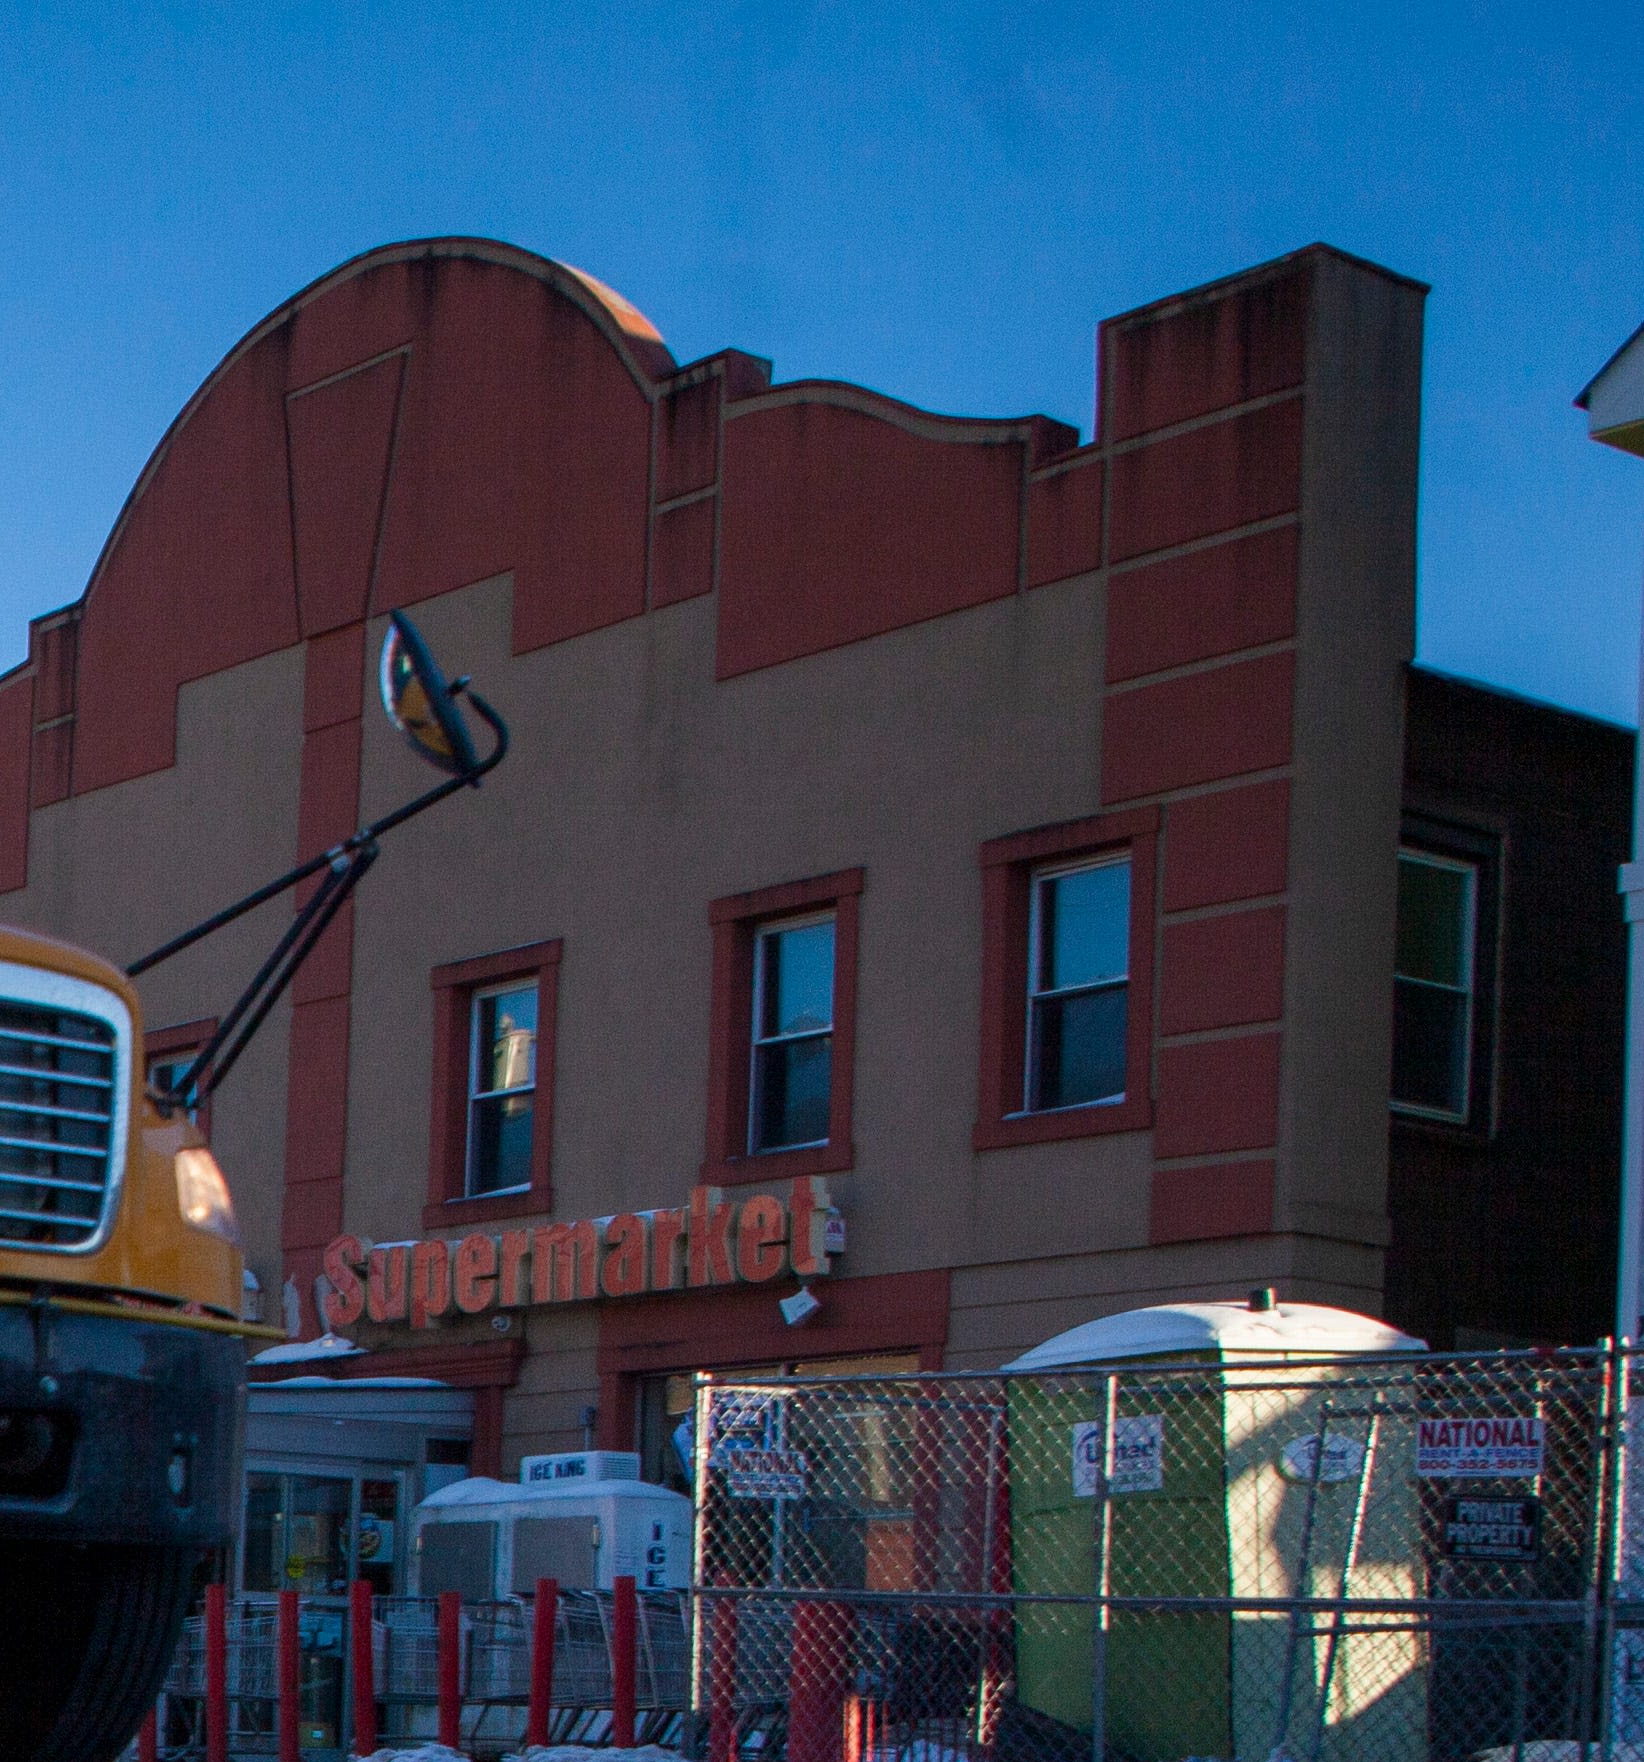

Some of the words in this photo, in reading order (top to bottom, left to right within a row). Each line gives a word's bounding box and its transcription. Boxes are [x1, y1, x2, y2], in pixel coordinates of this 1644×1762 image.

[323, 1175, 823, 1331] Supermarket
[1418, 1420, 1540, 1448] NATIONAL
[529, 1461, 552, 1481] ICE
[554, 1459, 585, 1478] KING
[1458, 1501, 1524, 1524] PRIVATE
[1445, 1523, 1533, 1545] PROPERTY
